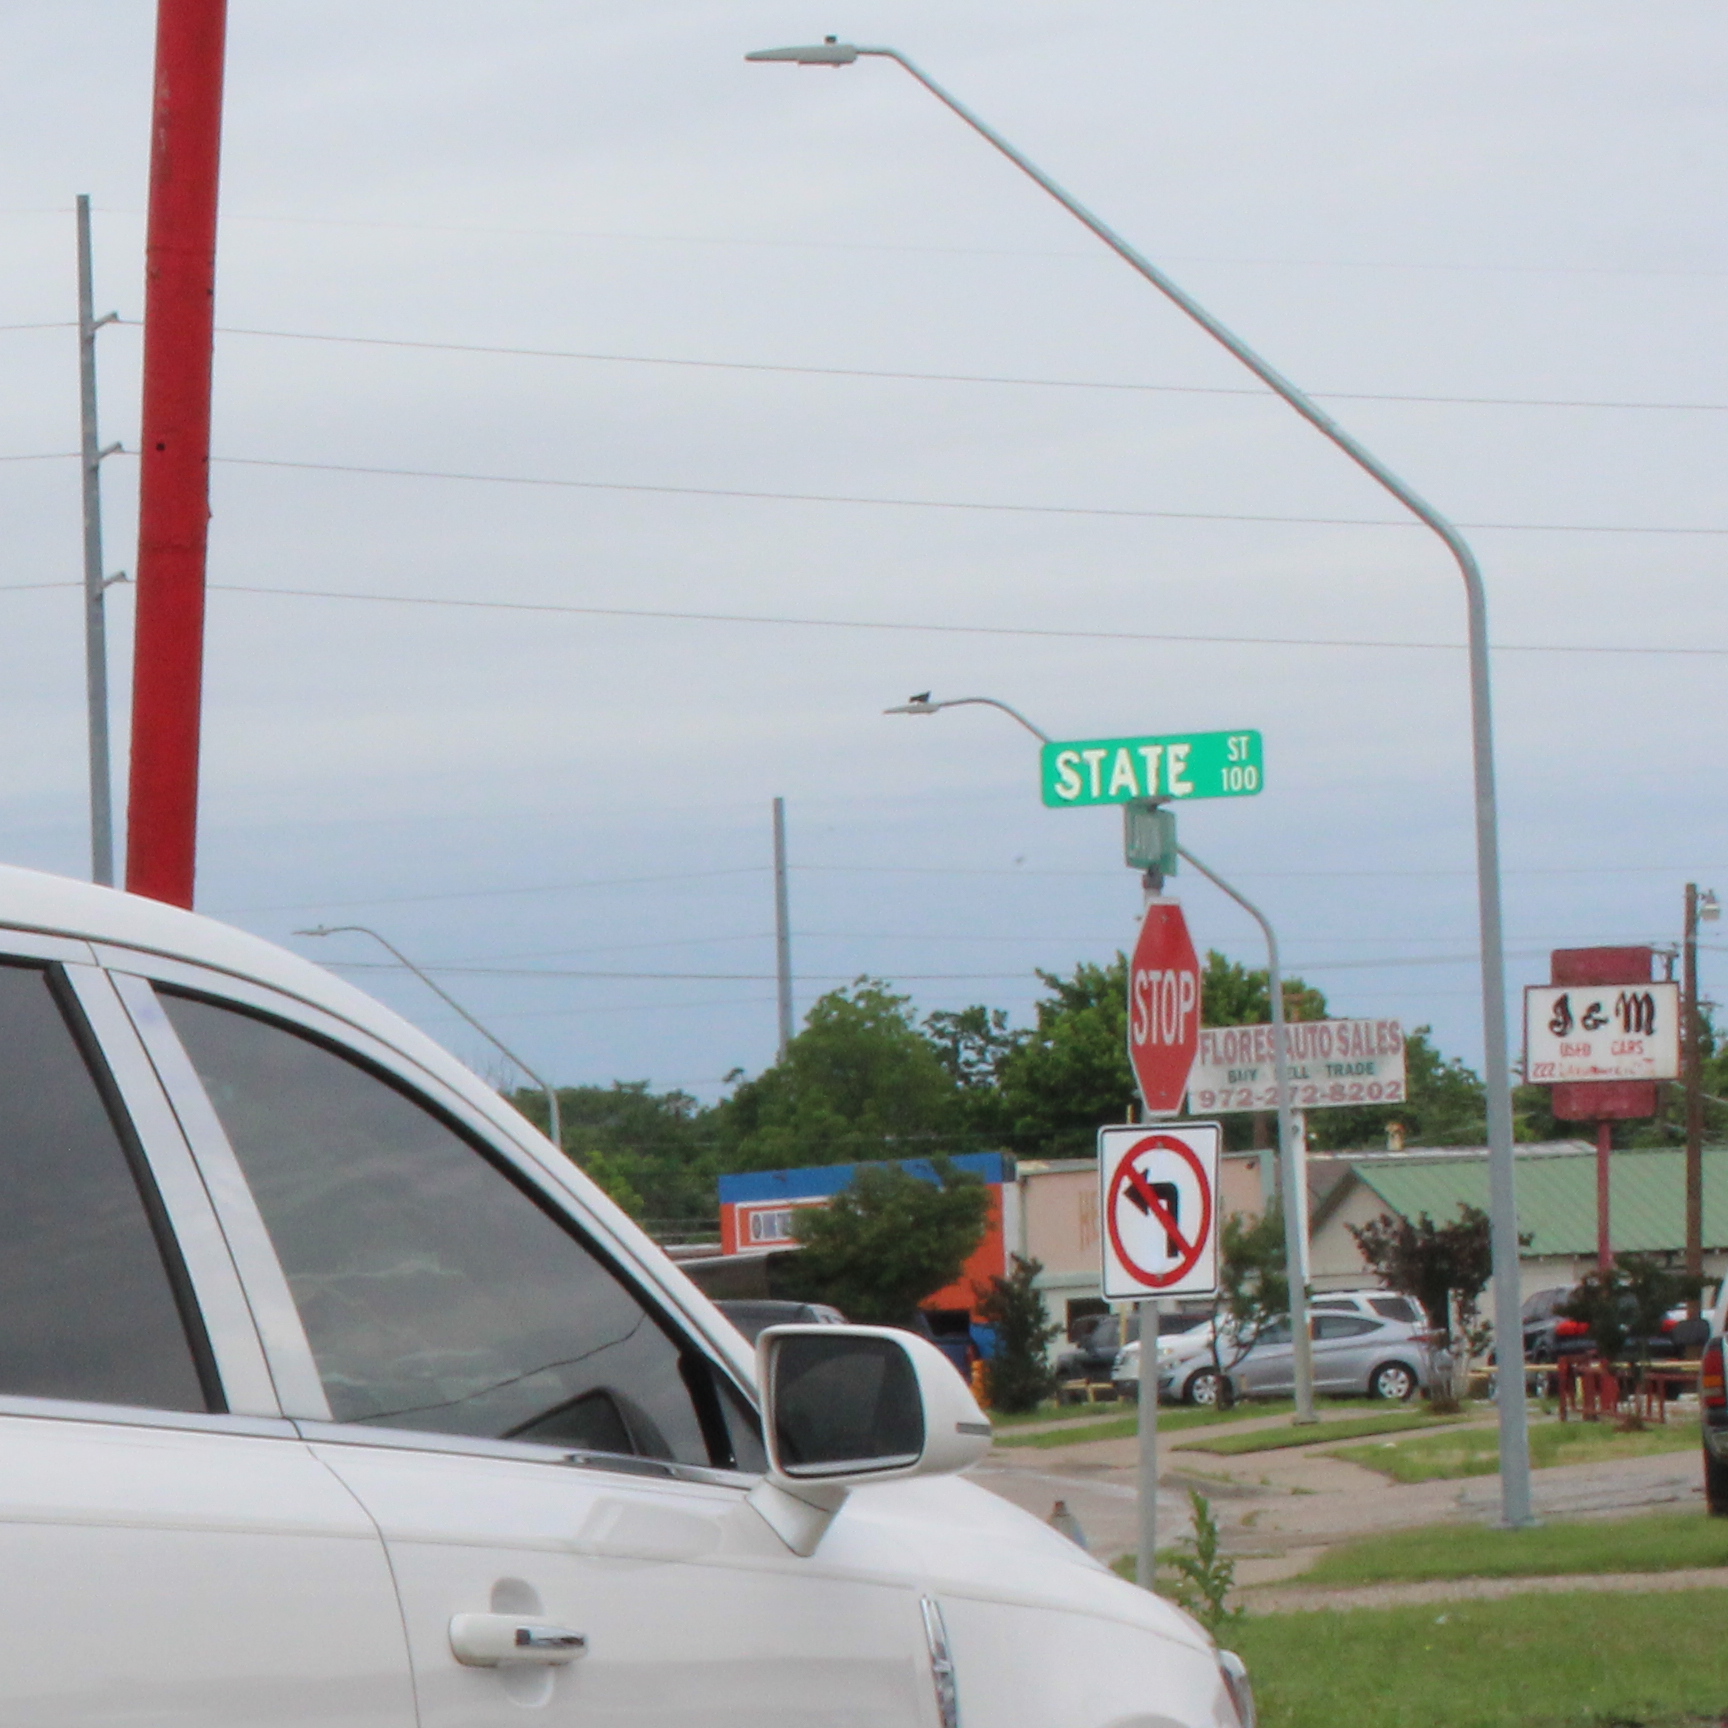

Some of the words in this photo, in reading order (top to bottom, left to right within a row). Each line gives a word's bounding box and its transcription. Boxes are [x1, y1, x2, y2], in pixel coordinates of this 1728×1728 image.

[1054, 743, 1194, 800] STATE
[1227, 735, 1250, 762] ST
[1221, 765, 1260, 792] 100
[1133, 968, 1196, 1046] STOP
[1580, 1001, 1610, 1031] &
[1615, 991, 1656, 1036] M
[1199, 1027, 1277, 1067] FLORES
[1336, 1020, 1401, 1057] SALES
[1559, 1041, 1592, 1057] USED
[1610, 1040, 1644, 1056] CARS
[1227, 1068, 1258, 1084] BUY
[1275, 1065, 1310, 1080] ELL
[1325, 1061, 1375, 1078] TRADE
[1532, 1061, 1556, 1078] 222
